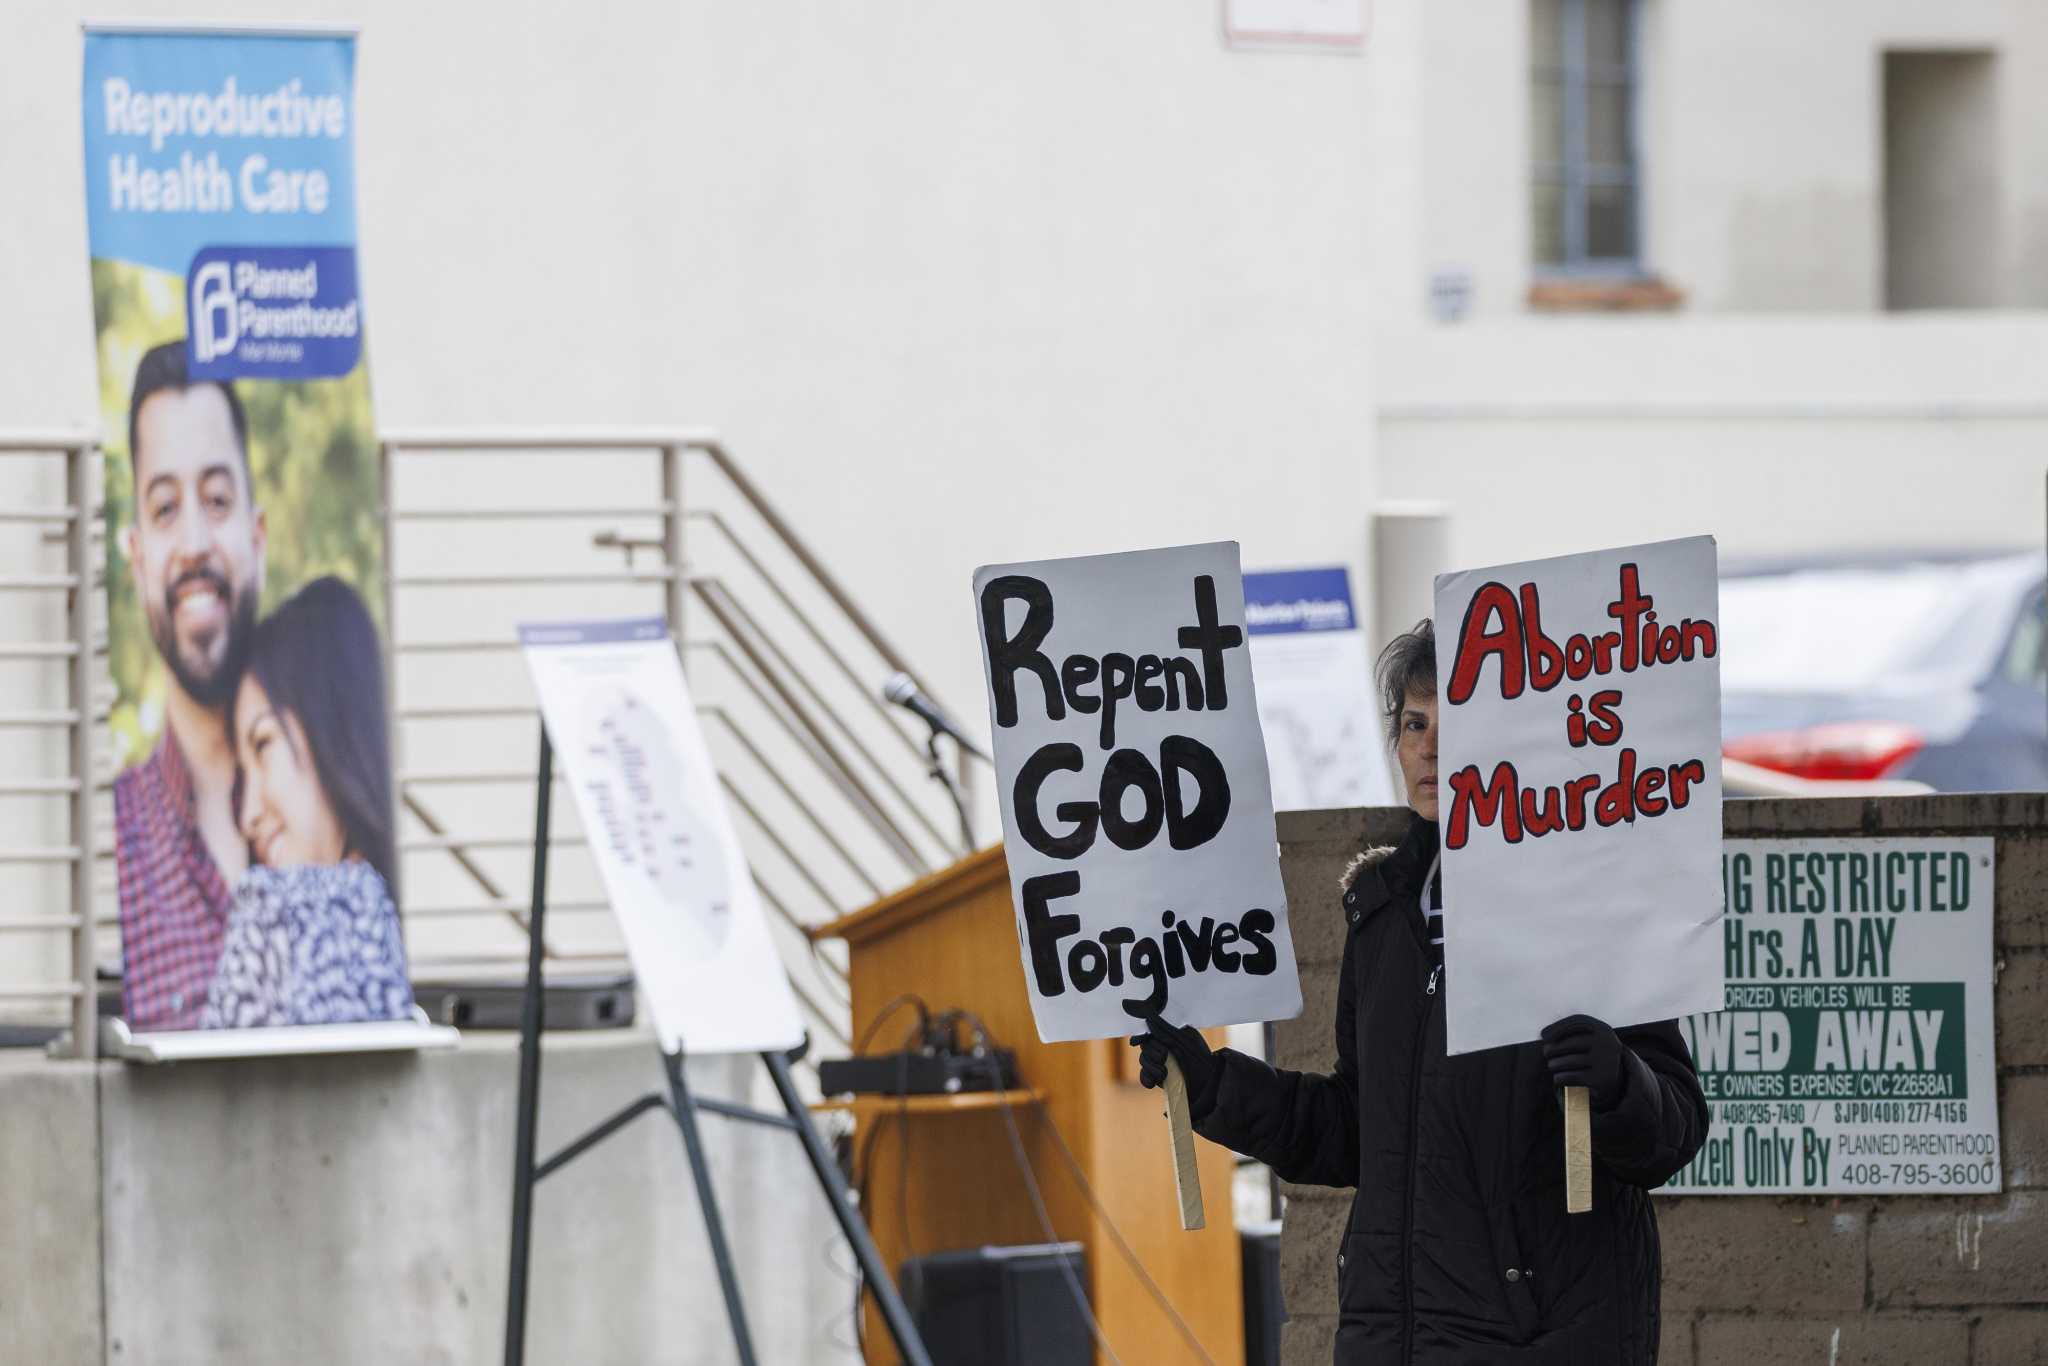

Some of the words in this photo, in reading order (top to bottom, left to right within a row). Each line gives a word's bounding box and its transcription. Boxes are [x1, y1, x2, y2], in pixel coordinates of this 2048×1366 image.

[104, 76, 344, 151] Reproductive
[109, 151, 233, 212] Health
[240, 153, 329, 214] Care
[235, 260, 318, 300] Planned
[239, 300, 358, 338] Parenthood
[981, 575, 1242, 750] Repent
[1447, 563, 1716, 705] Abortion
[1567, 690, 1623, 747] is
[1013, 734, 1231, 859] GOD
[1446, 748, 1705, 850] Murder
[1766, 851, 1971, 914] RESTRICTED
[1022, 870, 1277, 1019] Forgives
[1834, 917, 1896, 978] DAY
[1780, 986, 1848, 1008] VEHICLES
[1853, 986, 1887, 1007] WILL
[1892, 985, 1912, 1007] BE
[1814, 1010, 1945, 1071] AWAY
[1723, 1074, 1785, 1097] OWNERS
[1892, 1074, 1953, 1096] 22658A1
[1839, 1134, 1900, 1155] PLANNED
[1904, 1134, 1995, 1156] PARENTHOOD
[1842, 1163, 1994, 1185] 408-795-3600
